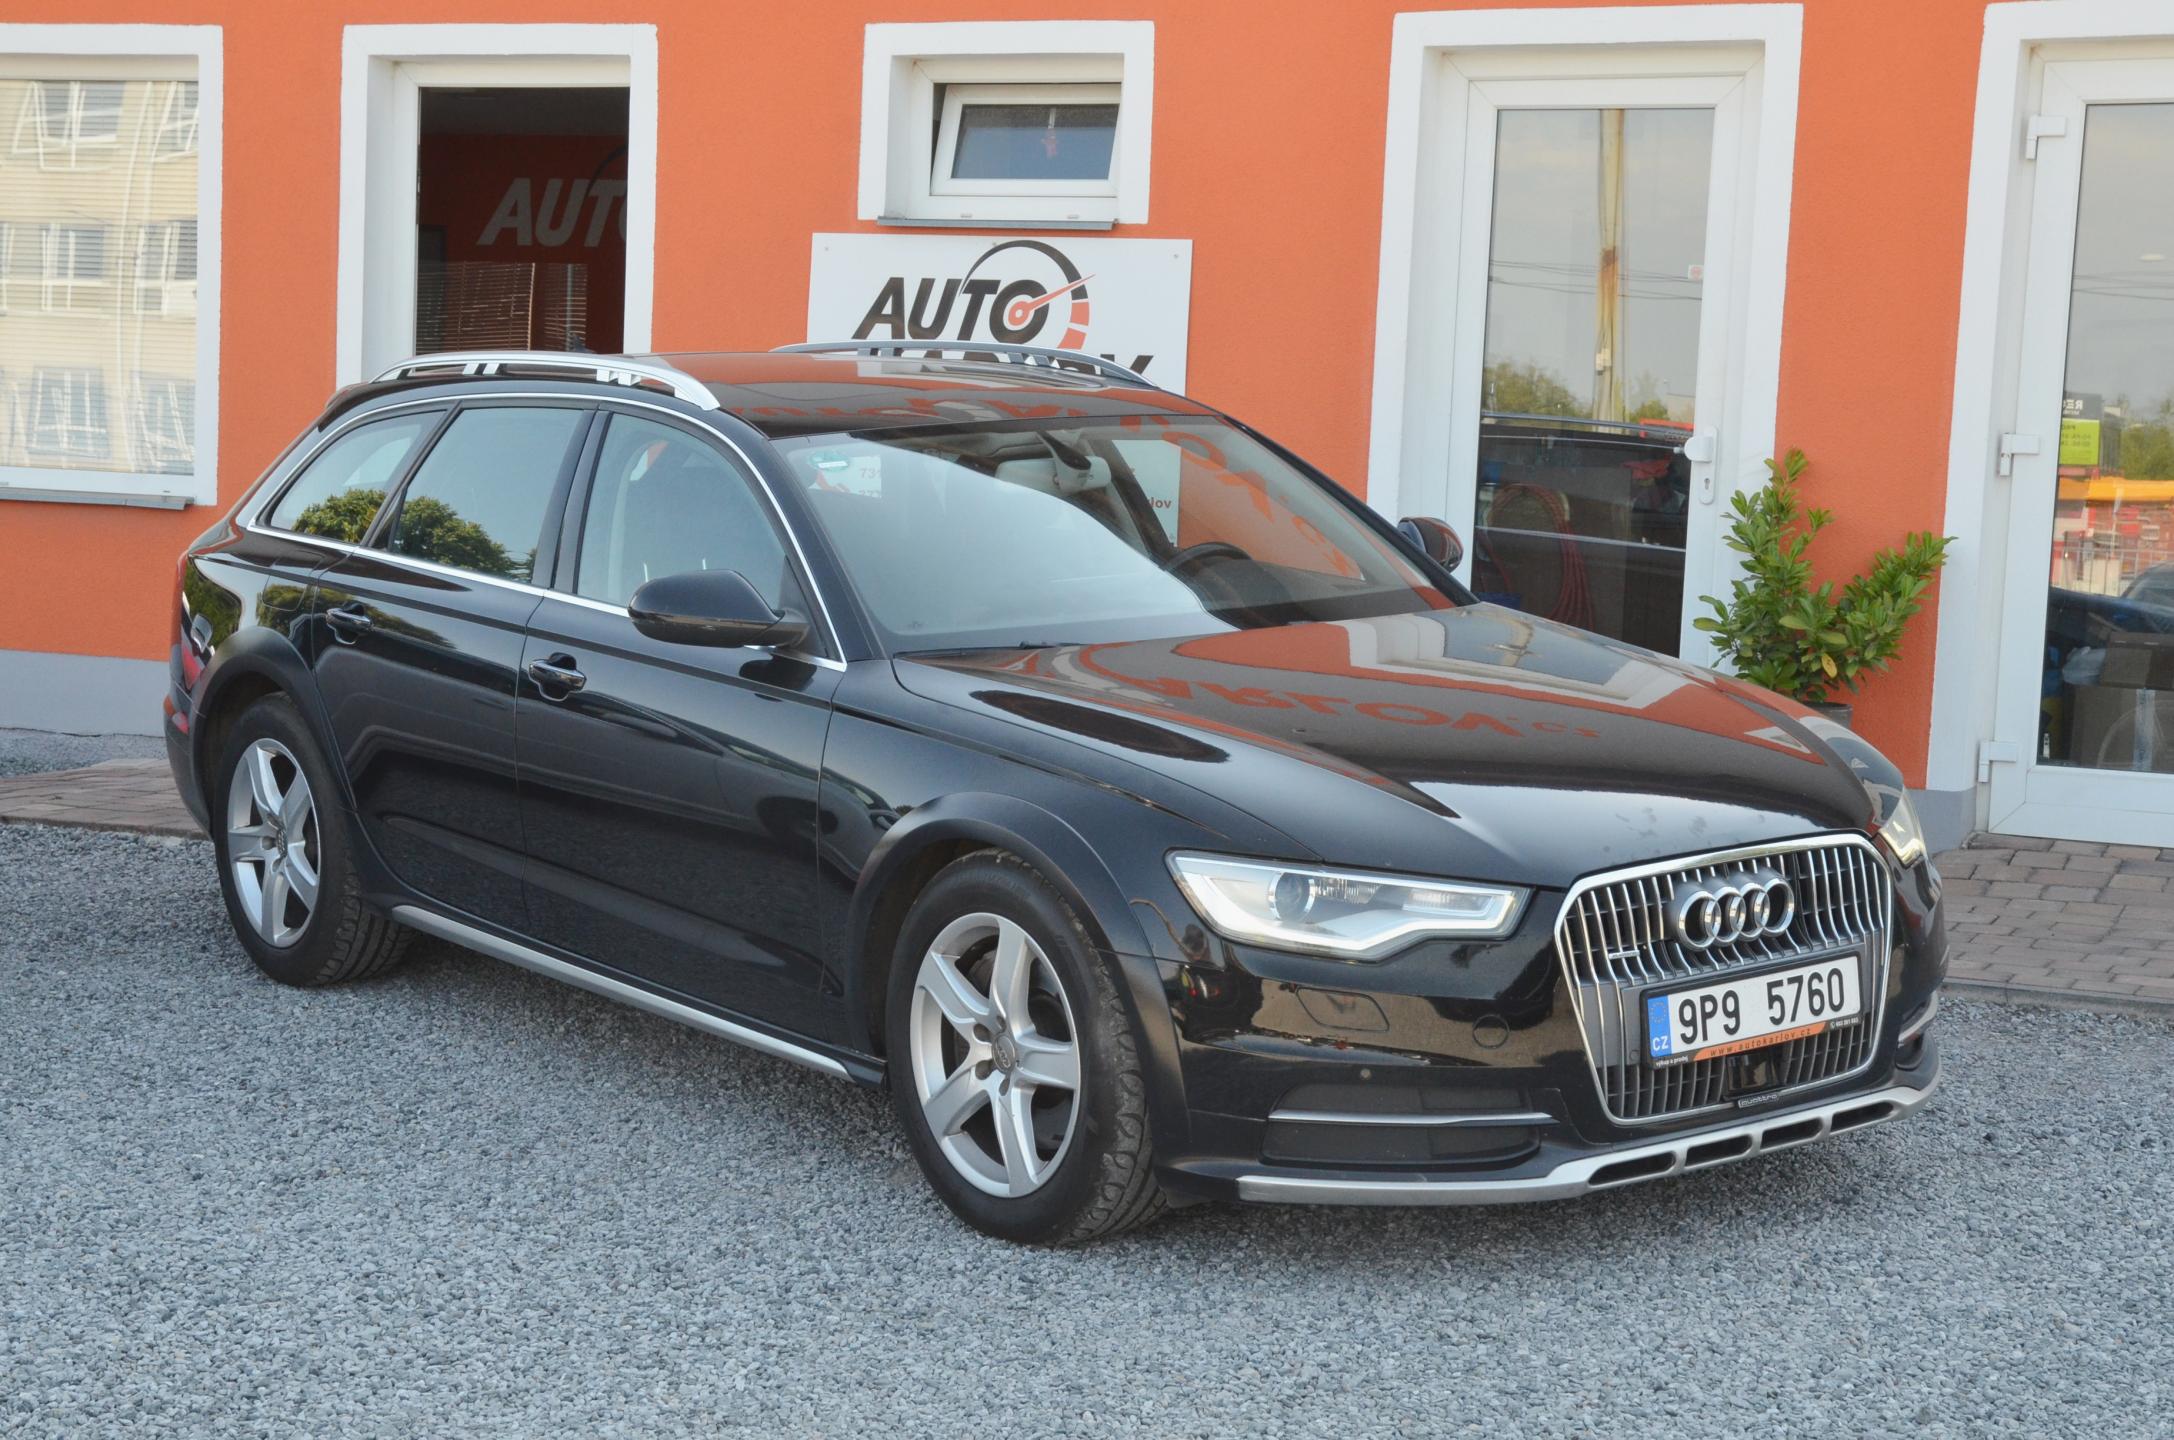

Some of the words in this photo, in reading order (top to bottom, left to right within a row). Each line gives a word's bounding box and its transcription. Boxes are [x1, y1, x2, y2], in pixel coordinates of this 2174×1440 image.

[476, 177, 628, 247] AUT
[851, 276, 1049, 346] AUTO
[1149, 497, 1172, 509] lov
[1678, 989, 1741, 1045] 9P9
[1766, 967, 1845, 1026] 5760
[1652, 1035, 1669, 1051] CZ
[1710, 1028, 1811, 1057] www.autokarlov.cz
[1741, 1093, 1778, 1107] quattro
